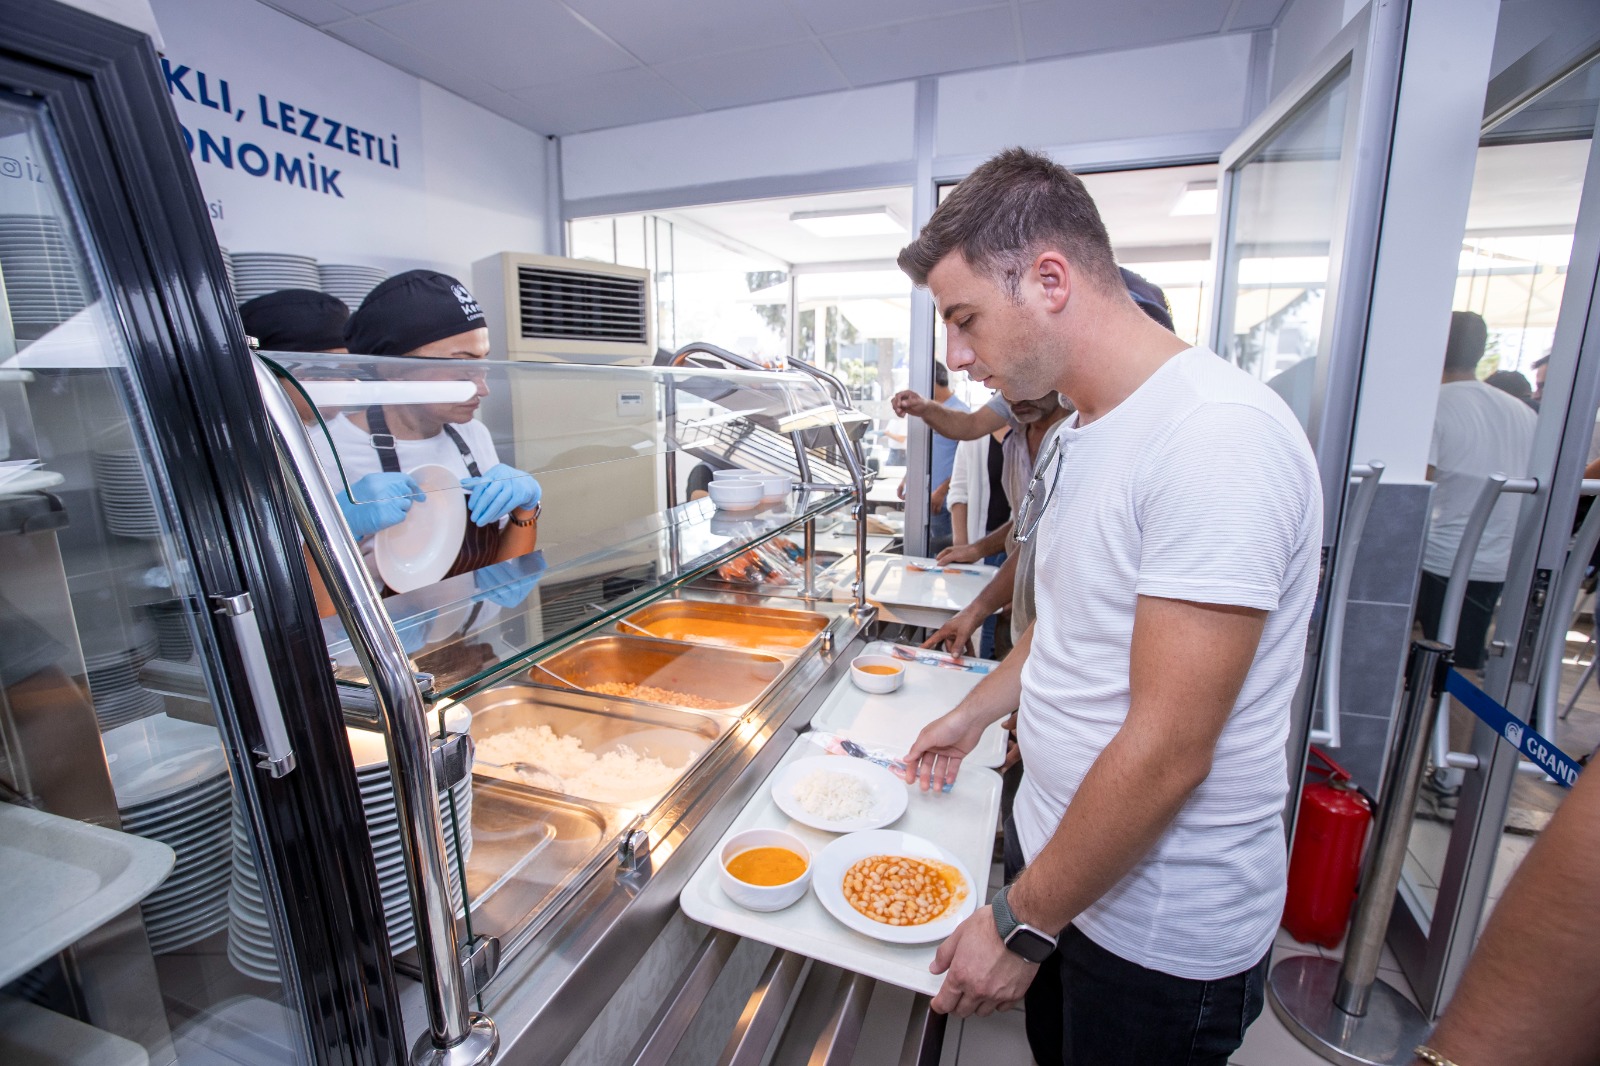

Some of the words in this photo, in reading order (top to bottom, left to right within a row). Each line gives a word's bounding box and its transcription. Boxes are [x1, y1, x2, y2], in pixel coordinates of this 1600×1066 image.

[160, 57, 245, 123] KLI,
[258, 93, 399, 169] LEZZETLİ
[1526, 737, 1579, 787] GRAND
